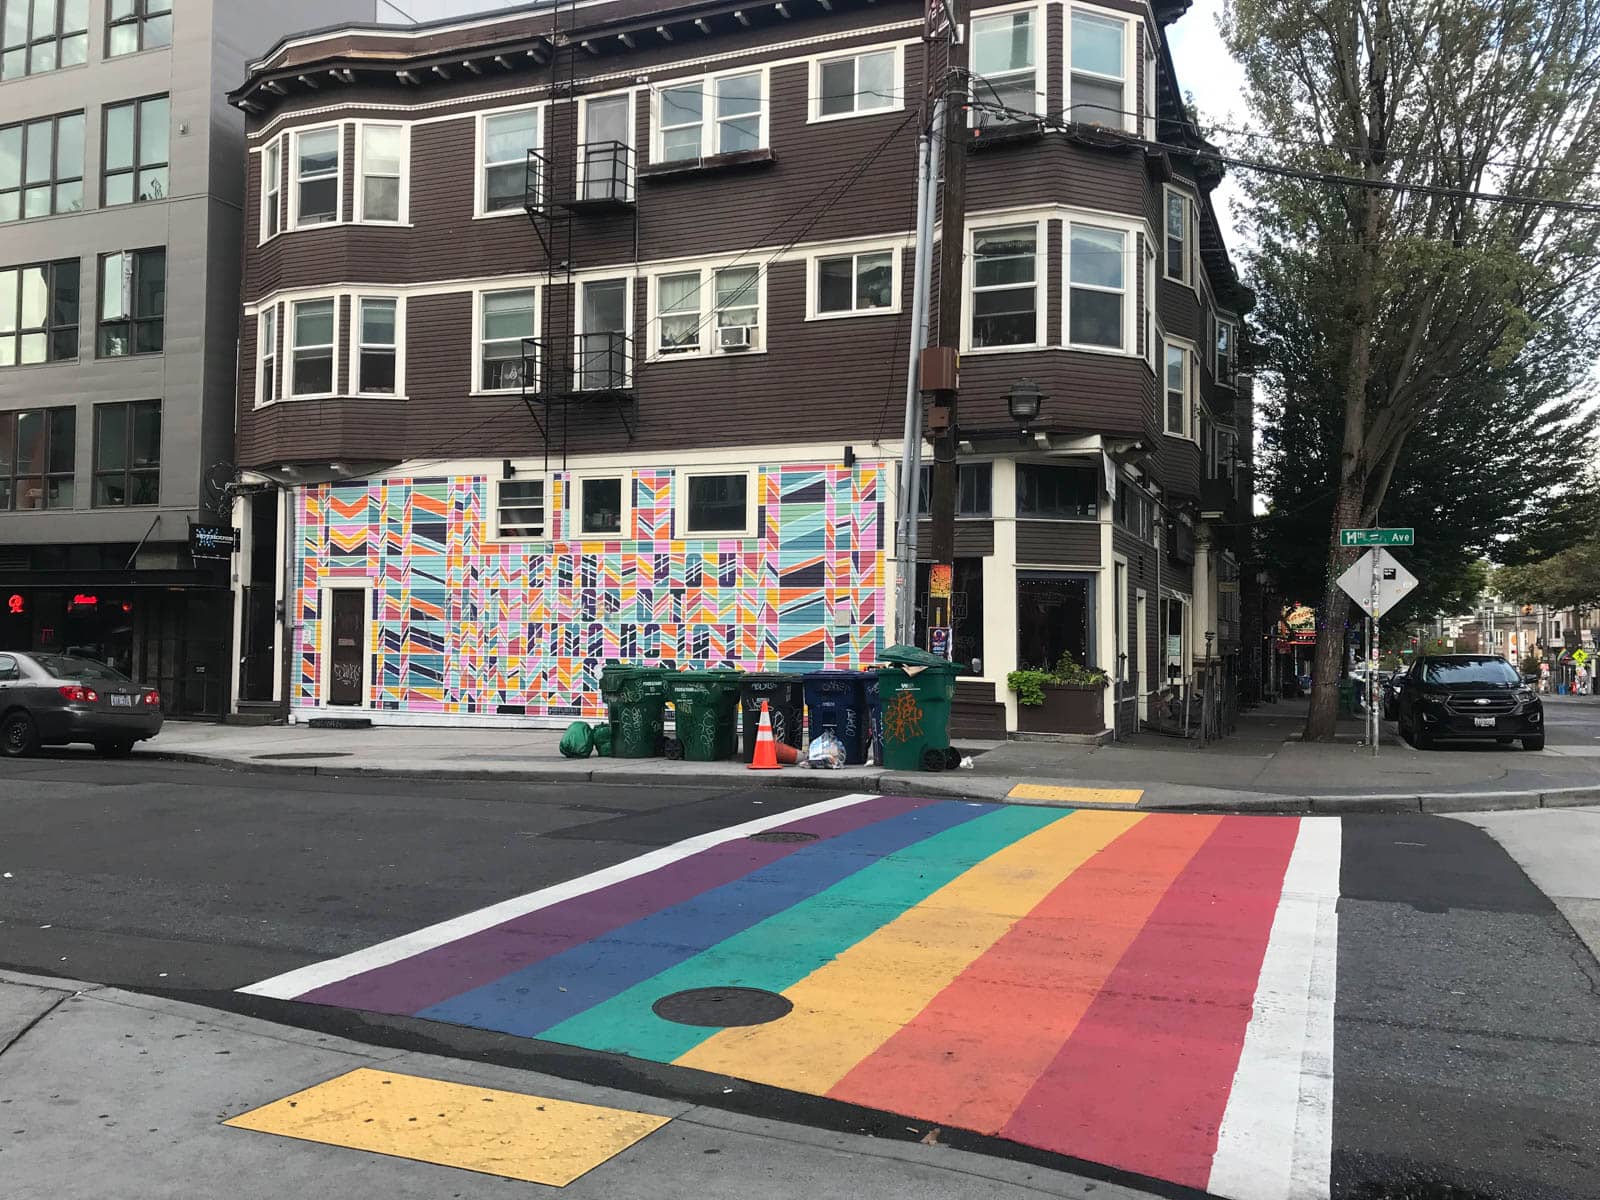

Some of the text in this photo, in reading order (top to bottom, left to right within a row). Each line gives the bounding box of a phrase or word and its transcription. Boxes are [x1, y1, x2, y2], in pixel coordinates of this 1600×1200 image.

[1391, 533, 1410, 542] Ave
[528, 552, 737, 588] CAN YOU
[581, 588, 686, 624] SPOT
[527, 622, 742, 660] FINANCIAL
